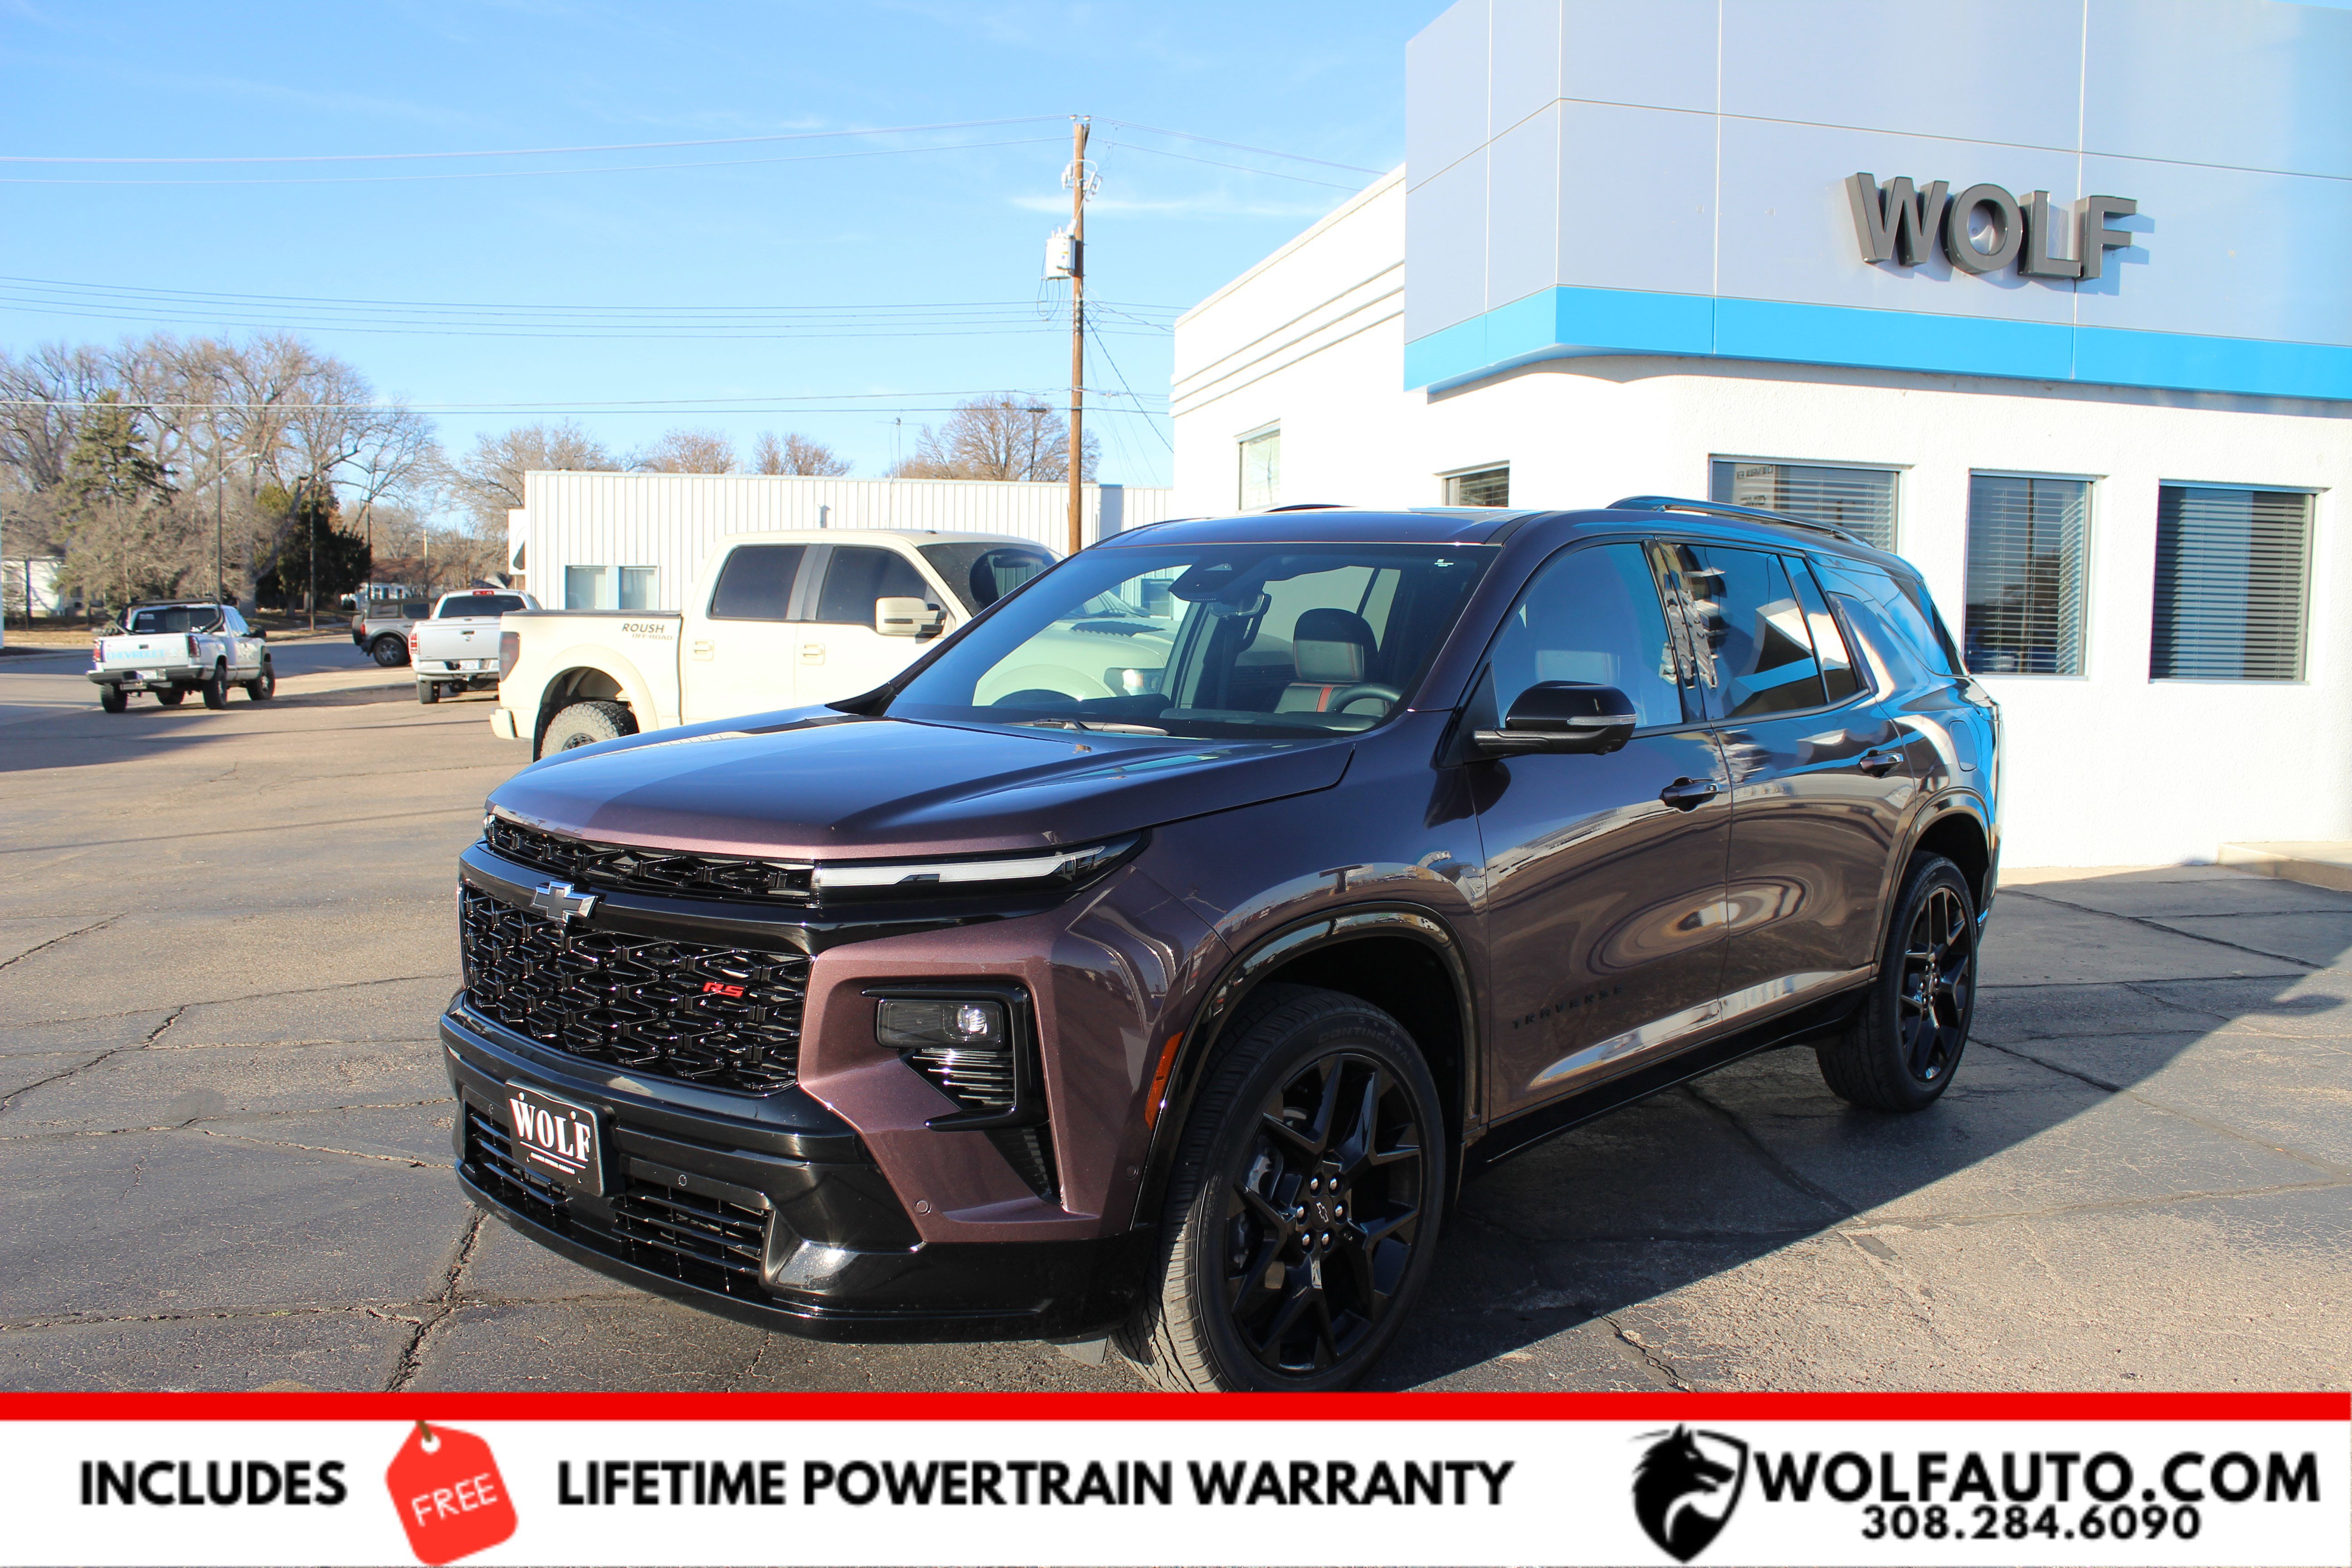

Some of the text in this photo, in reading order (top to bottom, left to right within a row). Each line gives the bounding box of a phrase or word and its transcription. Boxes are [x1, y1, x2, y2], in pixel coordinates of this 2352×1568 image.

[1845, 172, 2137, 281] WOLF
[622, 623, 665, 633] ROUSH
[106, 649, 164, 660] CHEVROLET
[703, 981, 745, 998] RS
[1512, 985, 1623, 1029] TRAVERSE
[509, 1098, 591, 1162] WOLF
